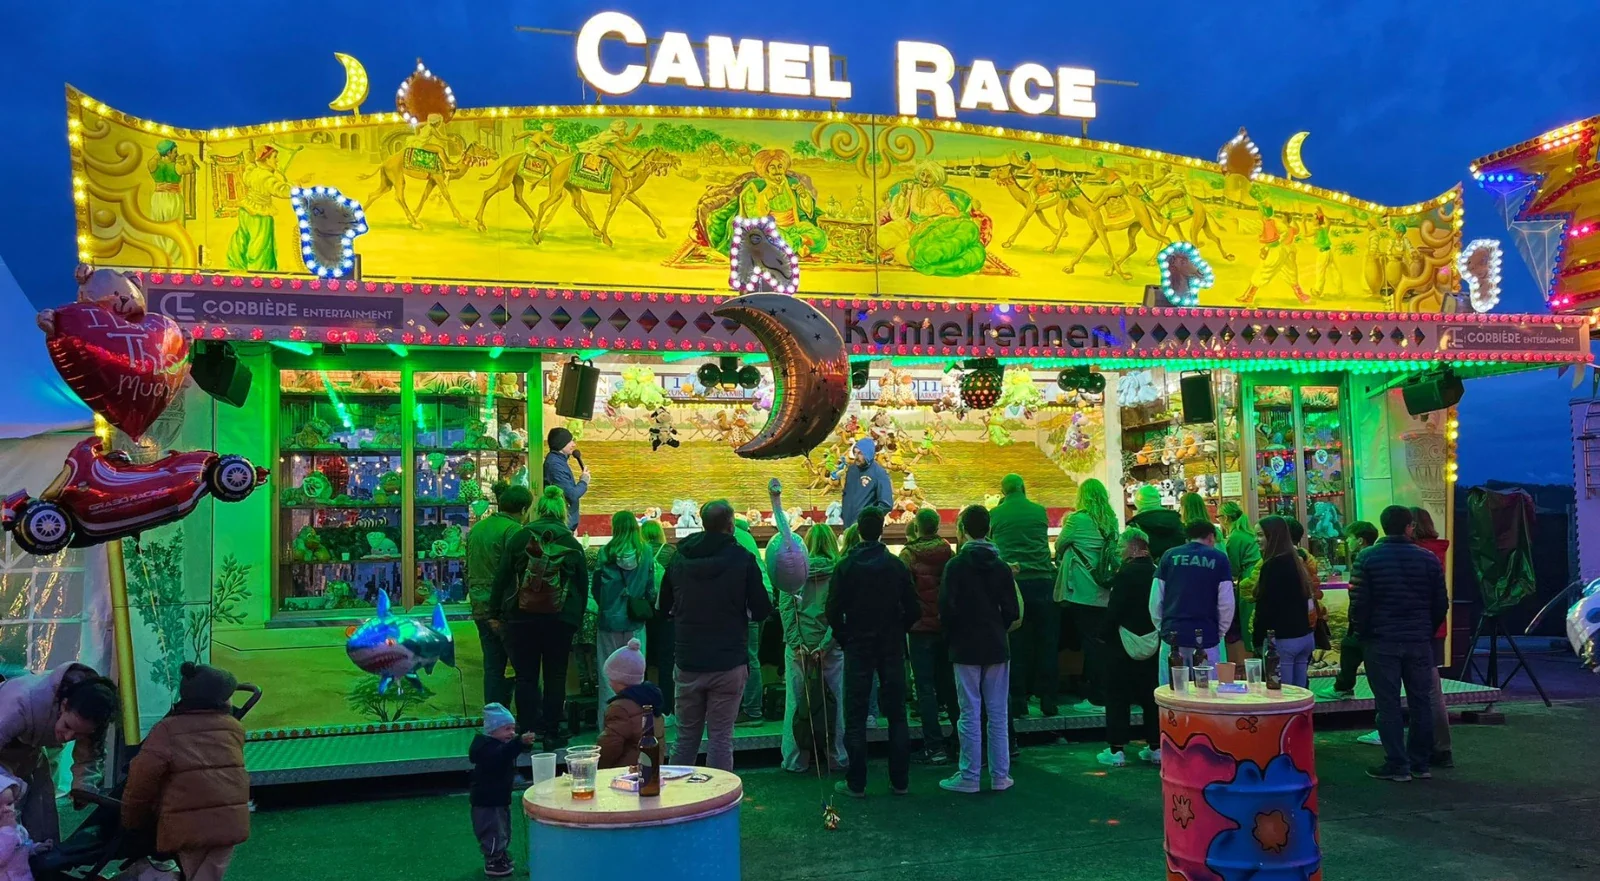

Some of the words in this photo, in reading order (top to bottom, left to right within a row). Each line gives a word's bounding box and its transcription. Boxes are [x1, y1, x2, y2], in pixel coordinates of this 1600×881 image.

[576, 11, 852, 99] CAMEL
[897, 40, 1097, 119] RACE
[81, 308, 108, 329] I
[202, 298, 298, 319] CORBIÈRE
[302, 307, 394, 320] ENTERTAINMENT
[1467, 330, 1521, 344] CORBIÈRE
[106, 333, 180, 375] This
[1172, 554, 1216, 570] TEAM
